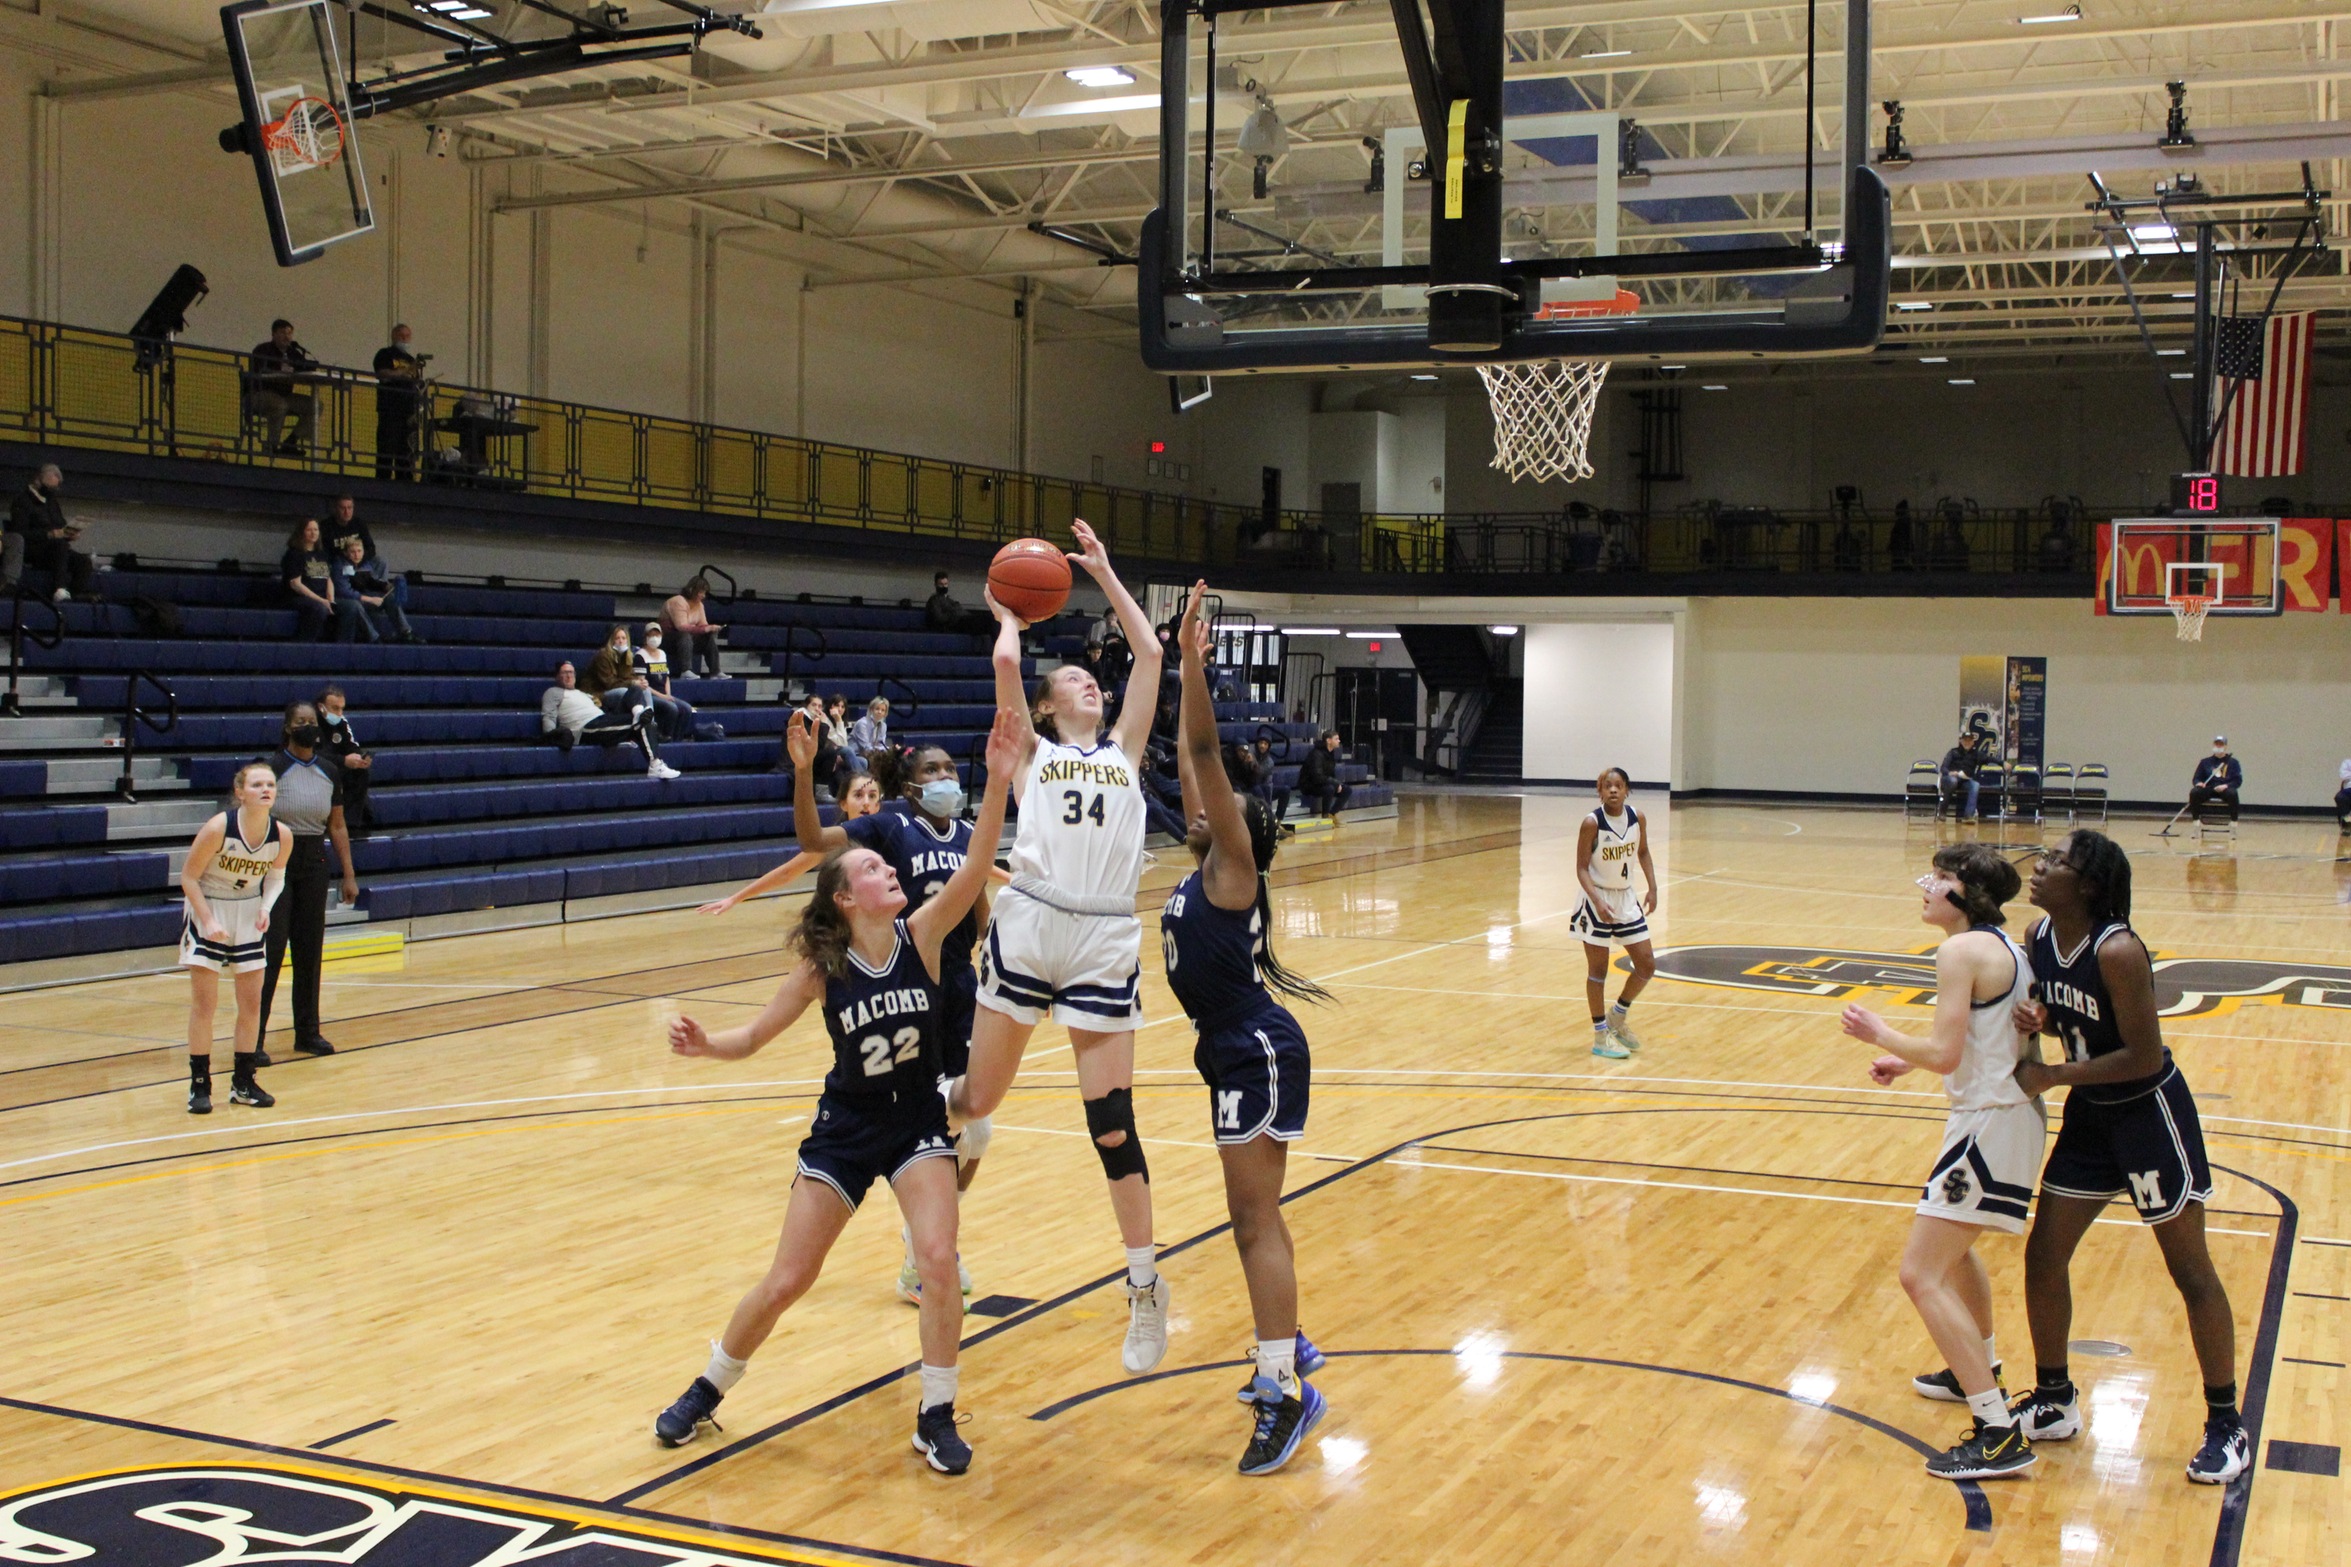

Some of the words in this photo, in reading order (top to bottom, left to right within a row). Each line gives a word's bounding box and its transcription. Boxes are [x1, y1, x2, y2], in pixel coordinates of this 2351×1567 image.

[2189, 479, 2217, 510] 18
[1040, 760, 1129, 787] SKIPPERS
[1063, 790, 1105, 827] 34
[1621, 862, 1628, 881] 4
[839, 988, 930, 1035] MACOMB
[2041, 981, 2100, 1021] ACOMB
[860, 1026, 920, 1077] 22
[1218, 1090, 1243, 1129] M
[2128, 1170, 2167, 1209] M
